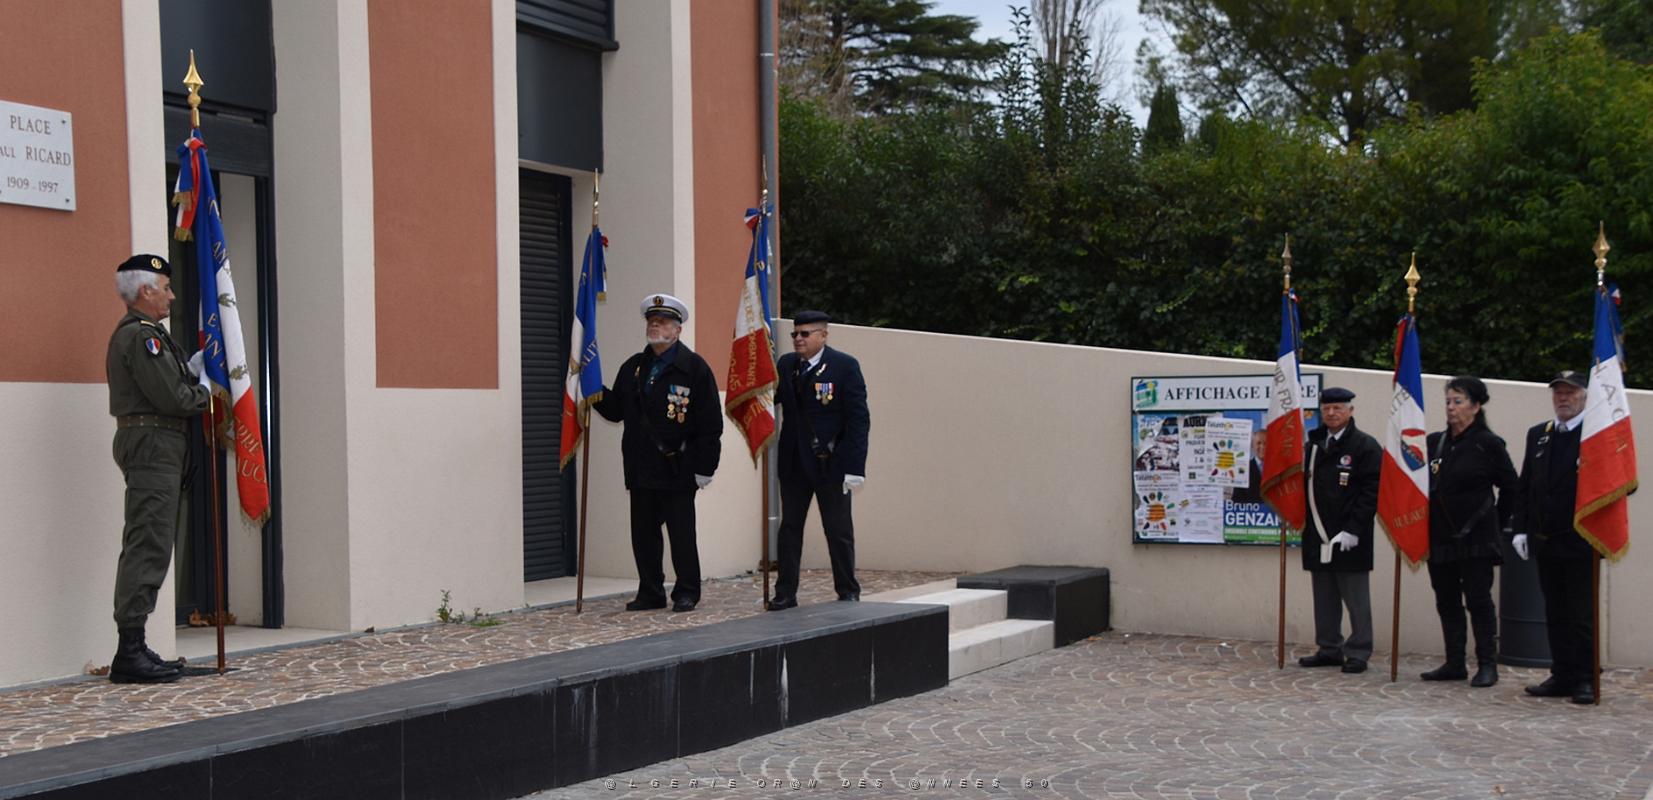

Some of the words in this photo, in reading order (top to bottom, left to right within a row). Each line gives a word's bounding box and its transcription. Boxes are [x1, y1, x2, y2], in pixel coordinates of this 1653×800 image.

[10, 115, 51, 135] PLACE
[25, 146, 71, 166] RICARD
[7, 176, 30, 190] 1909
[1165, 386, 1260, 401] AFFICHAGE
[1226, 500, 1260, 511] Bruno
